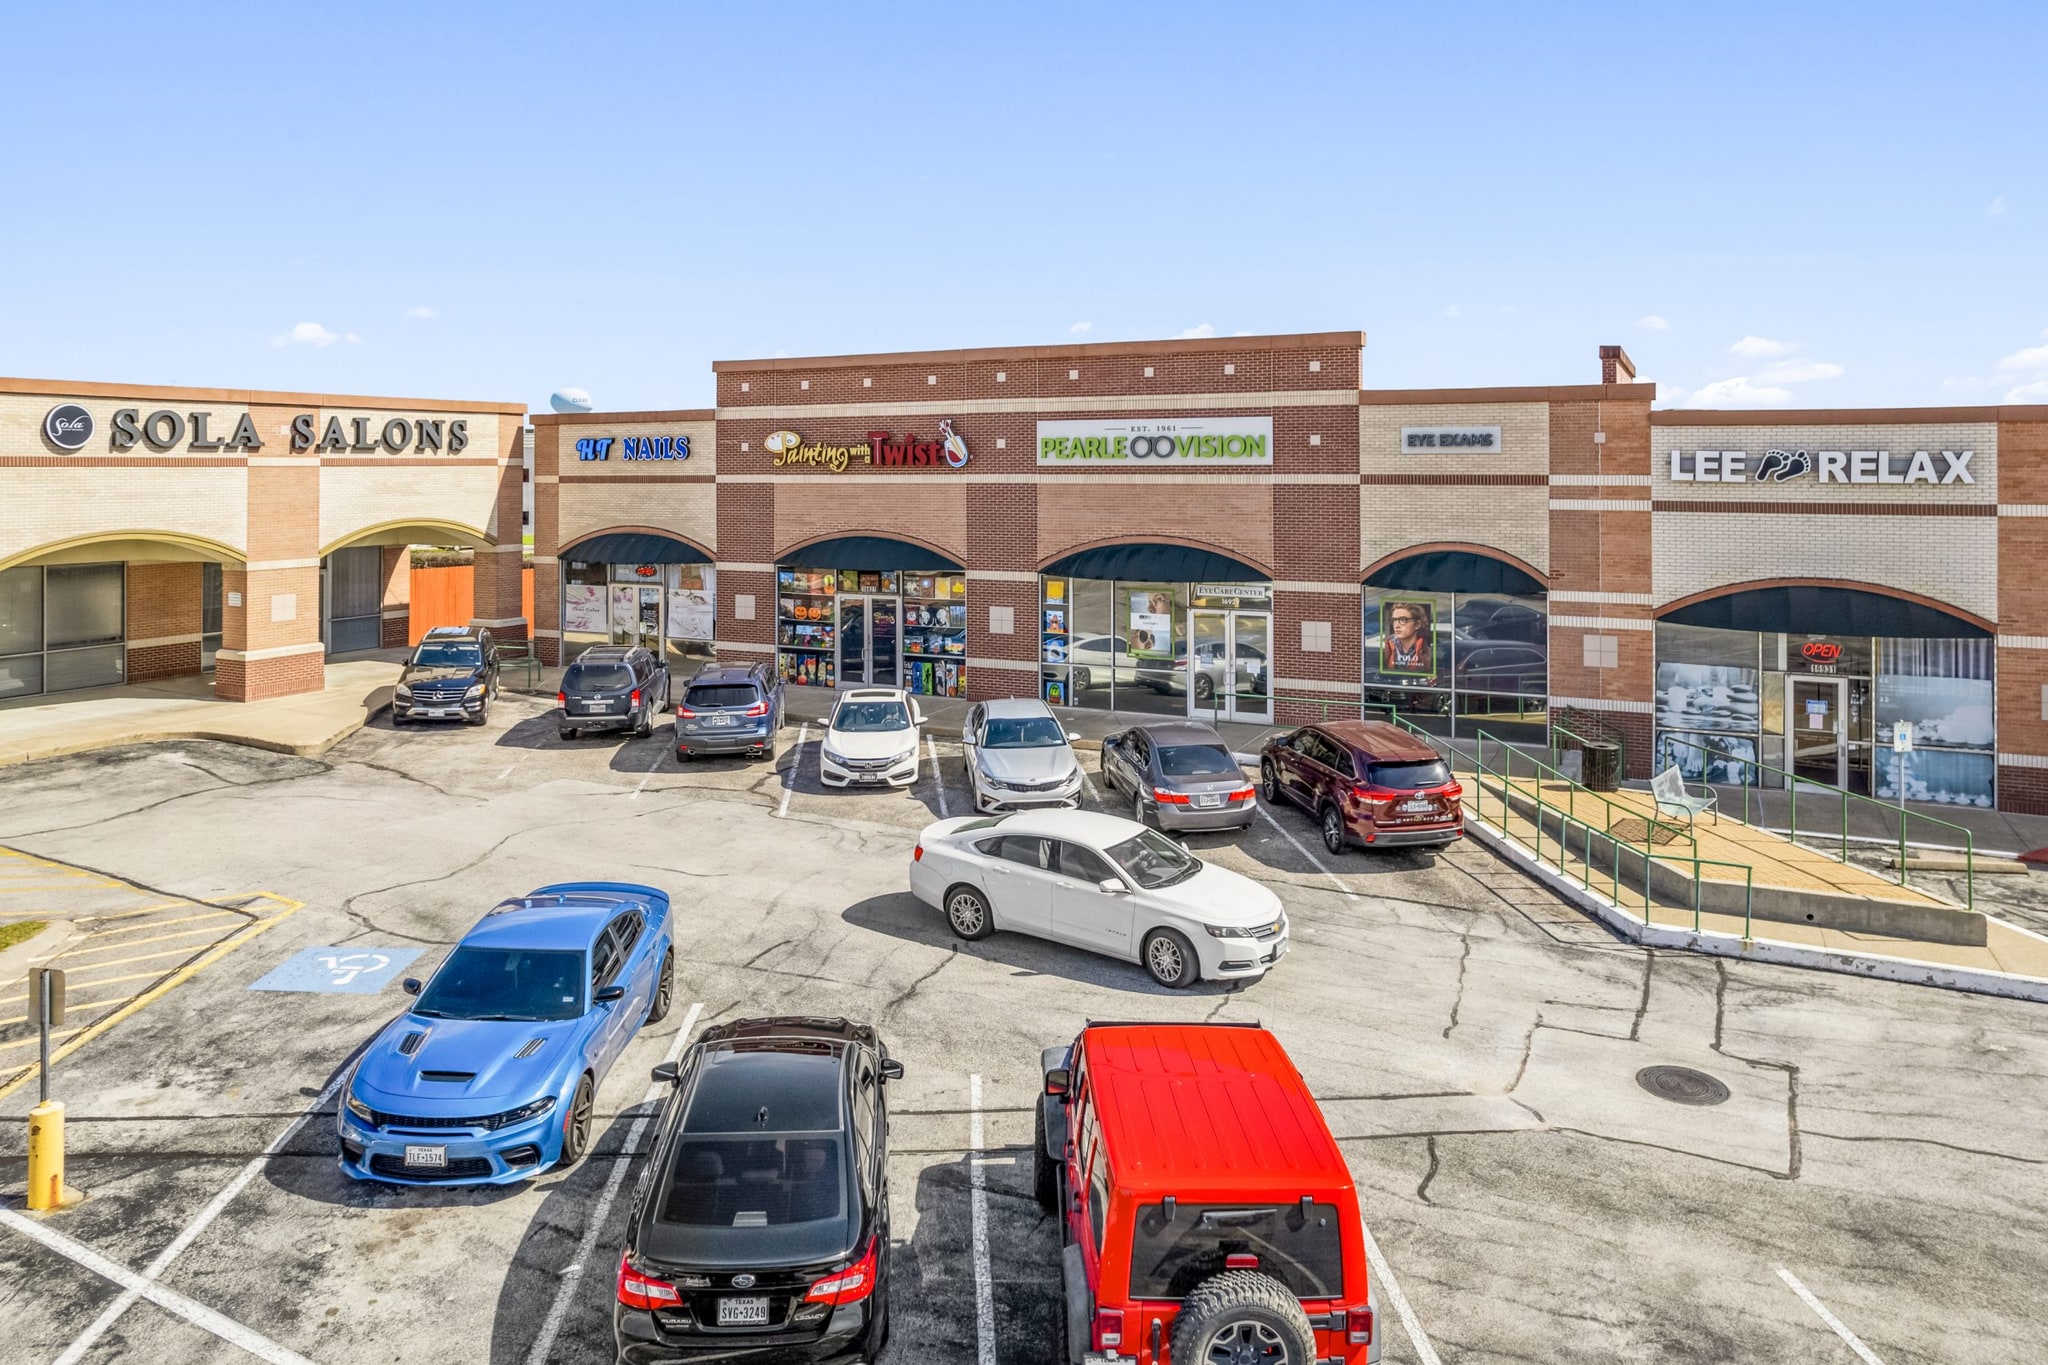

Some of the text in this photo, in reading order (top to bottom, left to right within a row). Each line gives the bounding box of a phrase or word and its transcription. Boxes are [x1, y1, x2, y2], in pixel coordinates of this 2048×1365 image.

[52, 415, 89, 437] Sola
[112, 408, 469, 451] SOLA SALONS
[1156, 424, 1177, 432] 1961
[576, 436, 689, 461] HT NAILS
[1040, 434, 1266, 459] PEARLE VISION
[1407, 433, 1494, 447] EYE EXAMS
[766, 431, 942, 473] Painting with a Twist
[1670, 450, 1976, 485] LEE RELAX
[1397, 654, 1419, 662] POLO
[1803, 642, 1841, 658] OPEN
